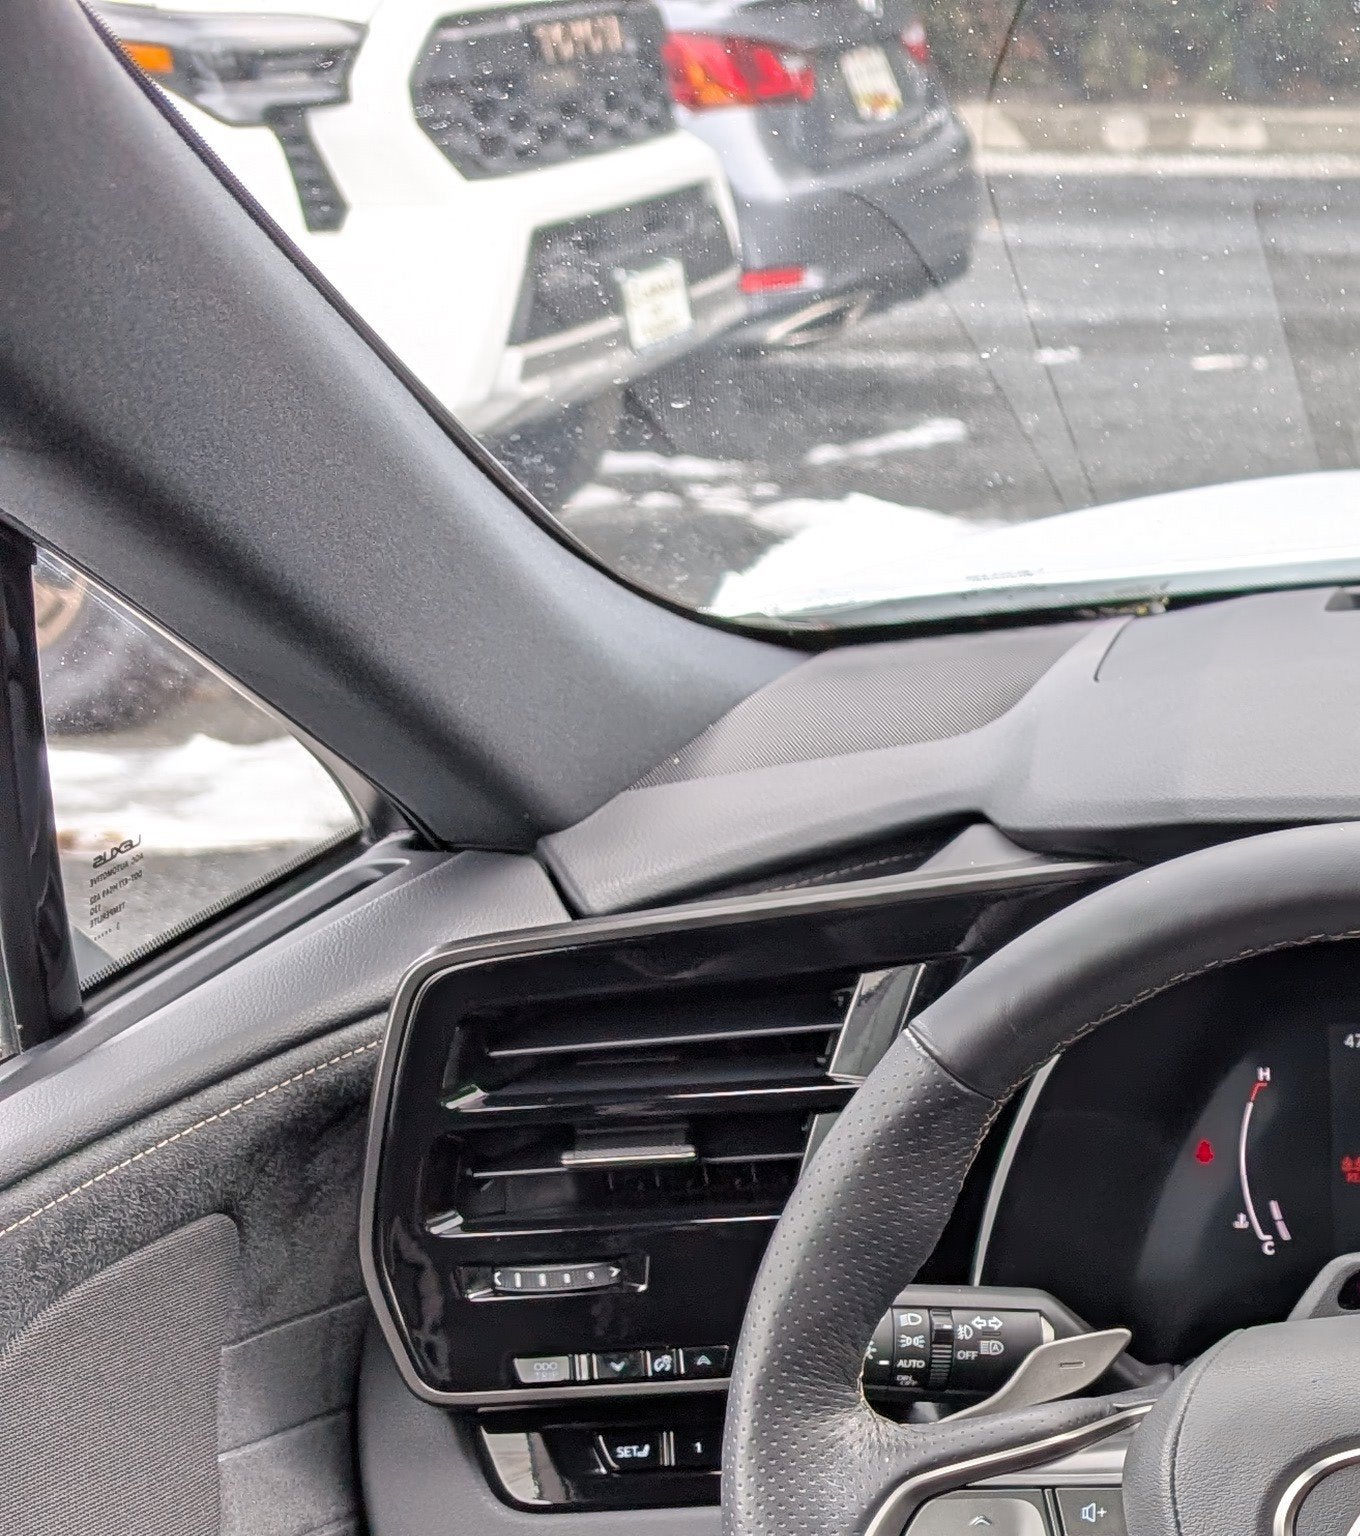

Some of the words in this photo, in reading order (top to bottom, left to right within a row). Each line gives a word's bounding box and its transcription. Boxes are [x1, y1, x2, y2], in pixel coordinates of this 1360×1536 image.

[1257, 1066, 1271, 1081] H
[1262, 1241, 1275, 1255] C
[956, 1350, 979, 1361] OFF
[897, 1359, 925, 1369] AUTO
[616, 1445, 639, 1459] SET
[695, 1442, 702, 1454] 1
